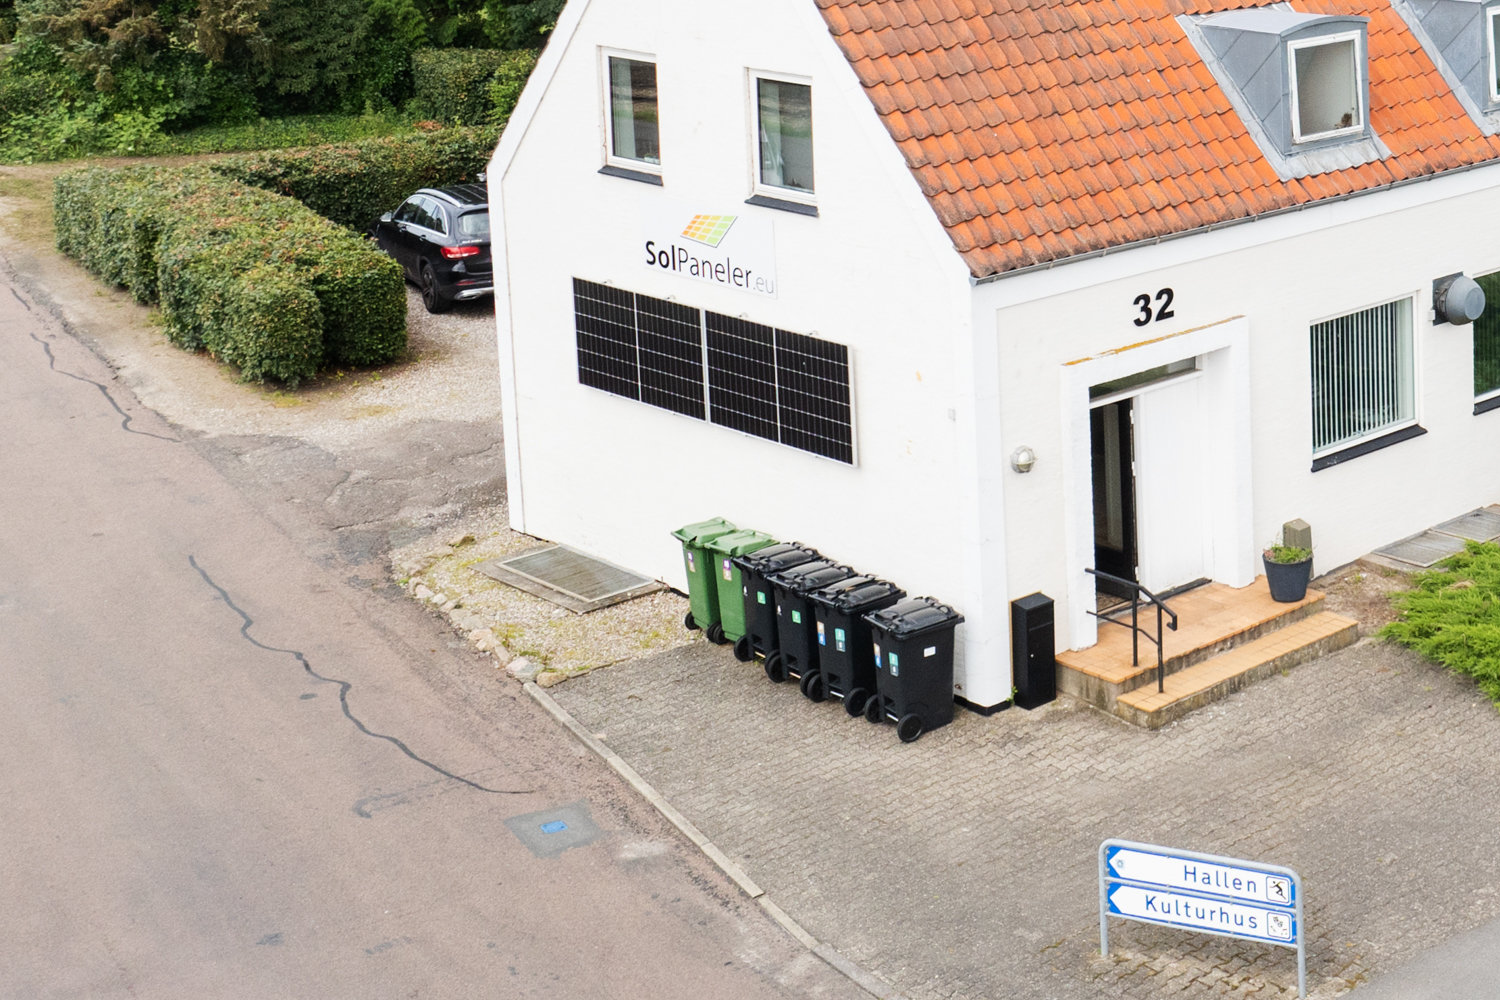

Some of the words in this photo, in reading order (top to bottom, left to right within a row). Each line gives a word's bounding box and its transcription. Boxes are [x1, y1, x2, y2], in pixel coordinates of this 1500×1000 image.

[645, 240, 775, 294] SolPaneler.eu
[1132, 287, 1175, 327] 32
[1183, 865, 1258, 894] Hallen
[1144, 894, 1259, 930] Kulturhus
